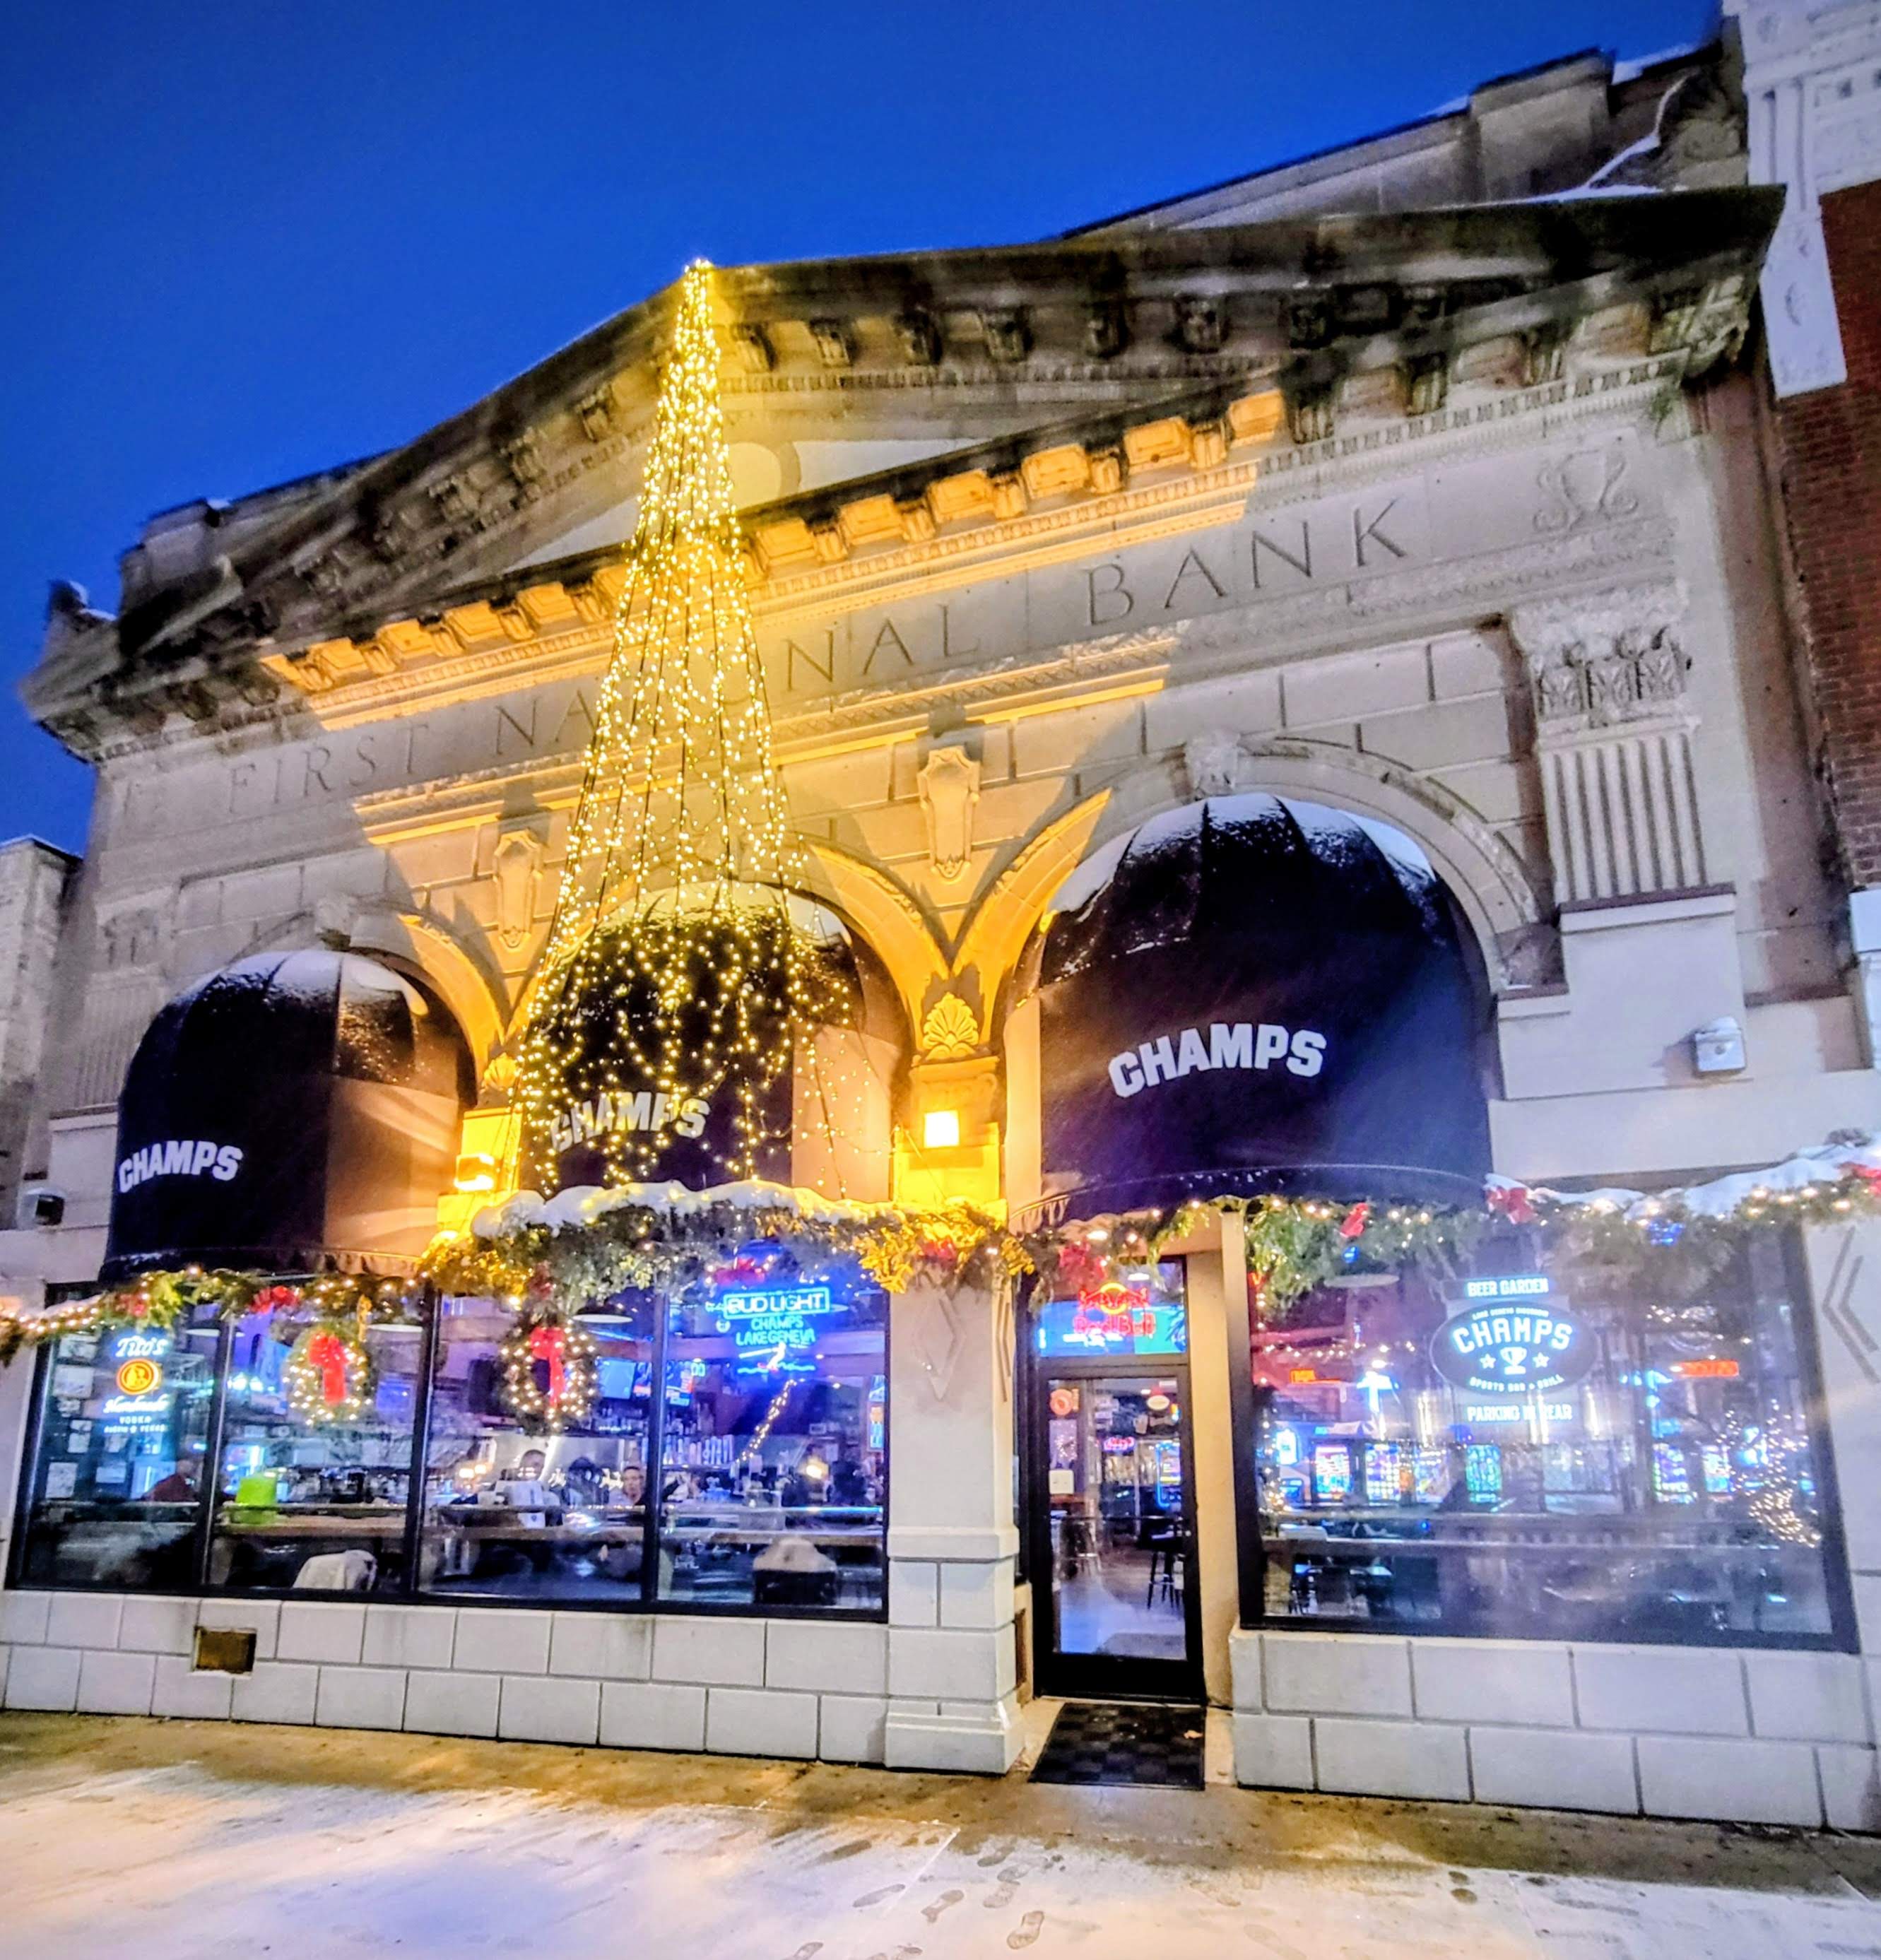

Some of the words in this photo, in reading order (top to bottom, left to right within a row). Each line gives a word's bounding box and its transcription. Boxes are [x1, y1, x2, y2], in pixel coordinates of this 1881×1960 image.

[227, 723, 429, 813] FIRST
[497, 603, 981, 755] NANAL
[1085, 499, 1408, 626] BANK
[1108, 1023, 1327, 1098] CHAMPS
[550, 1092, 710, 1152] CHAMPS
[119, 1140, 243, 1193] CHAMPS
[1467, 1280, 1497, 1297] BEER
[1499, 1277, 1550, 1295] GARDEN
[727, 1297, 768, 1313] BUD
[770, 1293, 824, 1312] LIGHT
[751, 1315, 804, 1330] CHAMPS
[736, 1330, 767, 1346] LAKE
[767, 1328, 816, 1344] GENEVA
[1453, 1317, 1572, 1351] CHAMPS
[1469, 1376, 1504, 1392] SPORTS
[1467, 1405, 1520, 1422] PARKING
